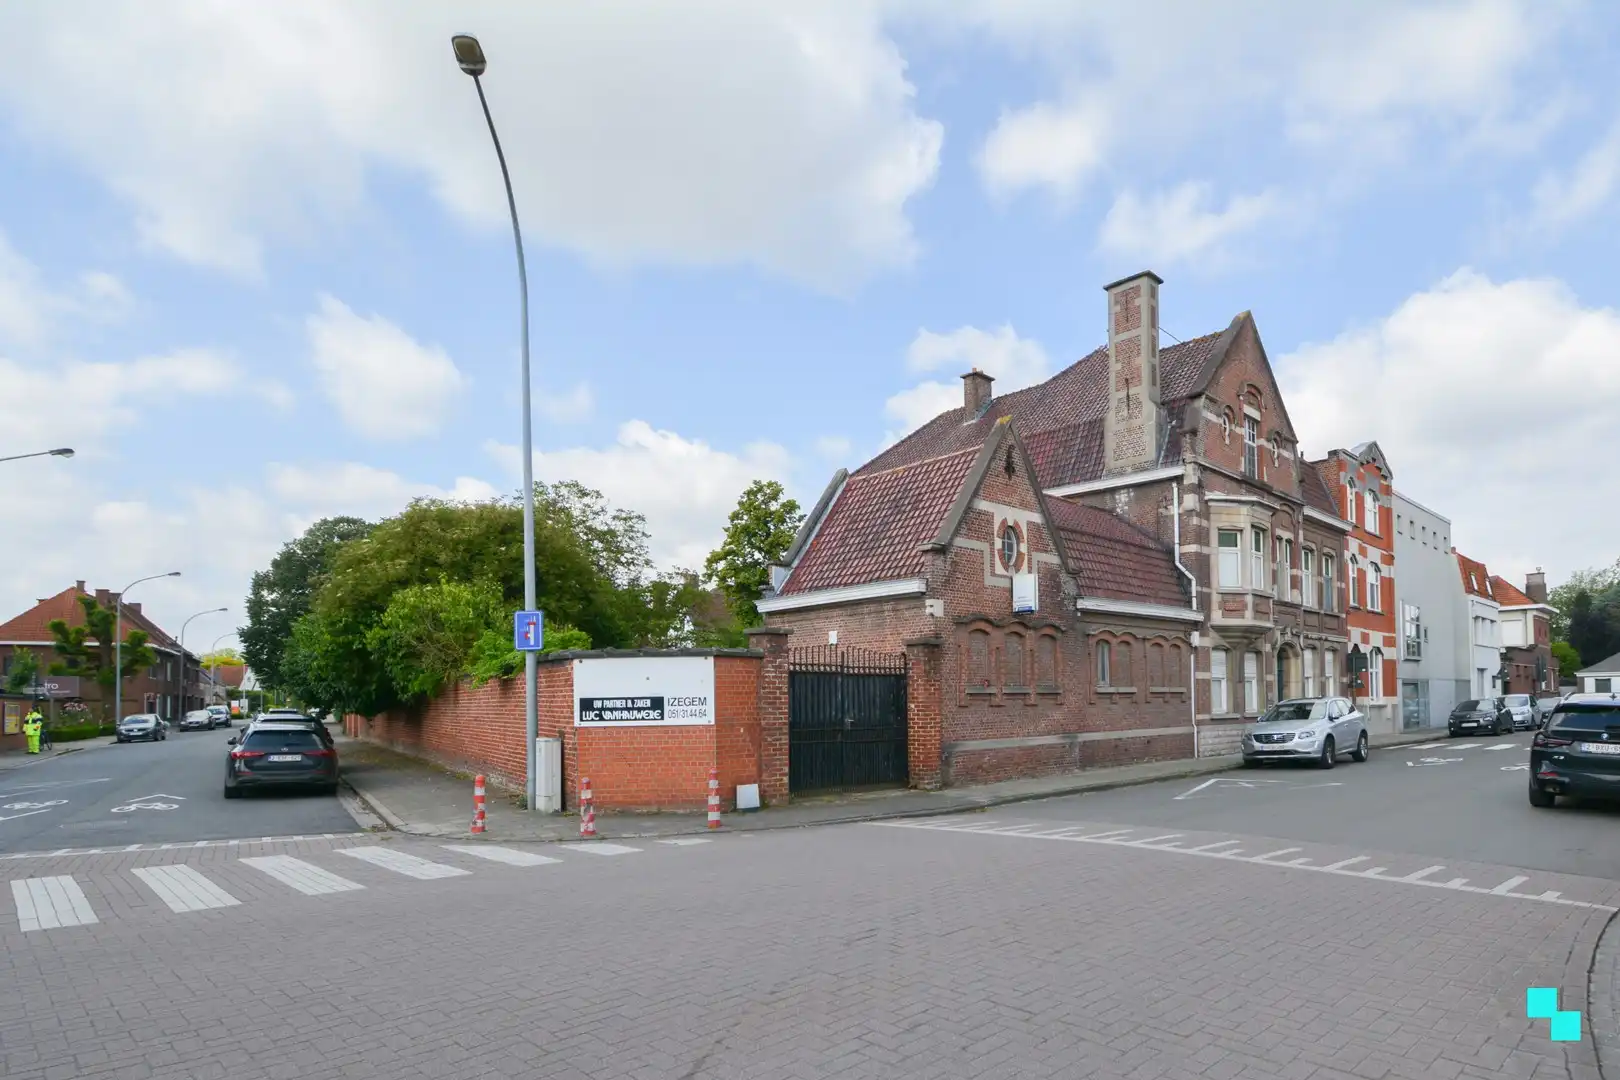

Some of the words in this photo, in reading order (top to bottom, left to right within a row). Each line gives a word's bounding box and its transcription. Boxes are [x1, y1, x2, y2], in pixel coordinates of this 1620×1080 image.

[593, 699, 602, 709] UW
[603, 699, 626, 708] PARTNER
[634, 698, 651, 708] ZAKEN
[668, 696, 707, 707] IZEGEM
[582, 711, 600, 721] LUC
[601, 709, 662, 720] VANHAUWERE
